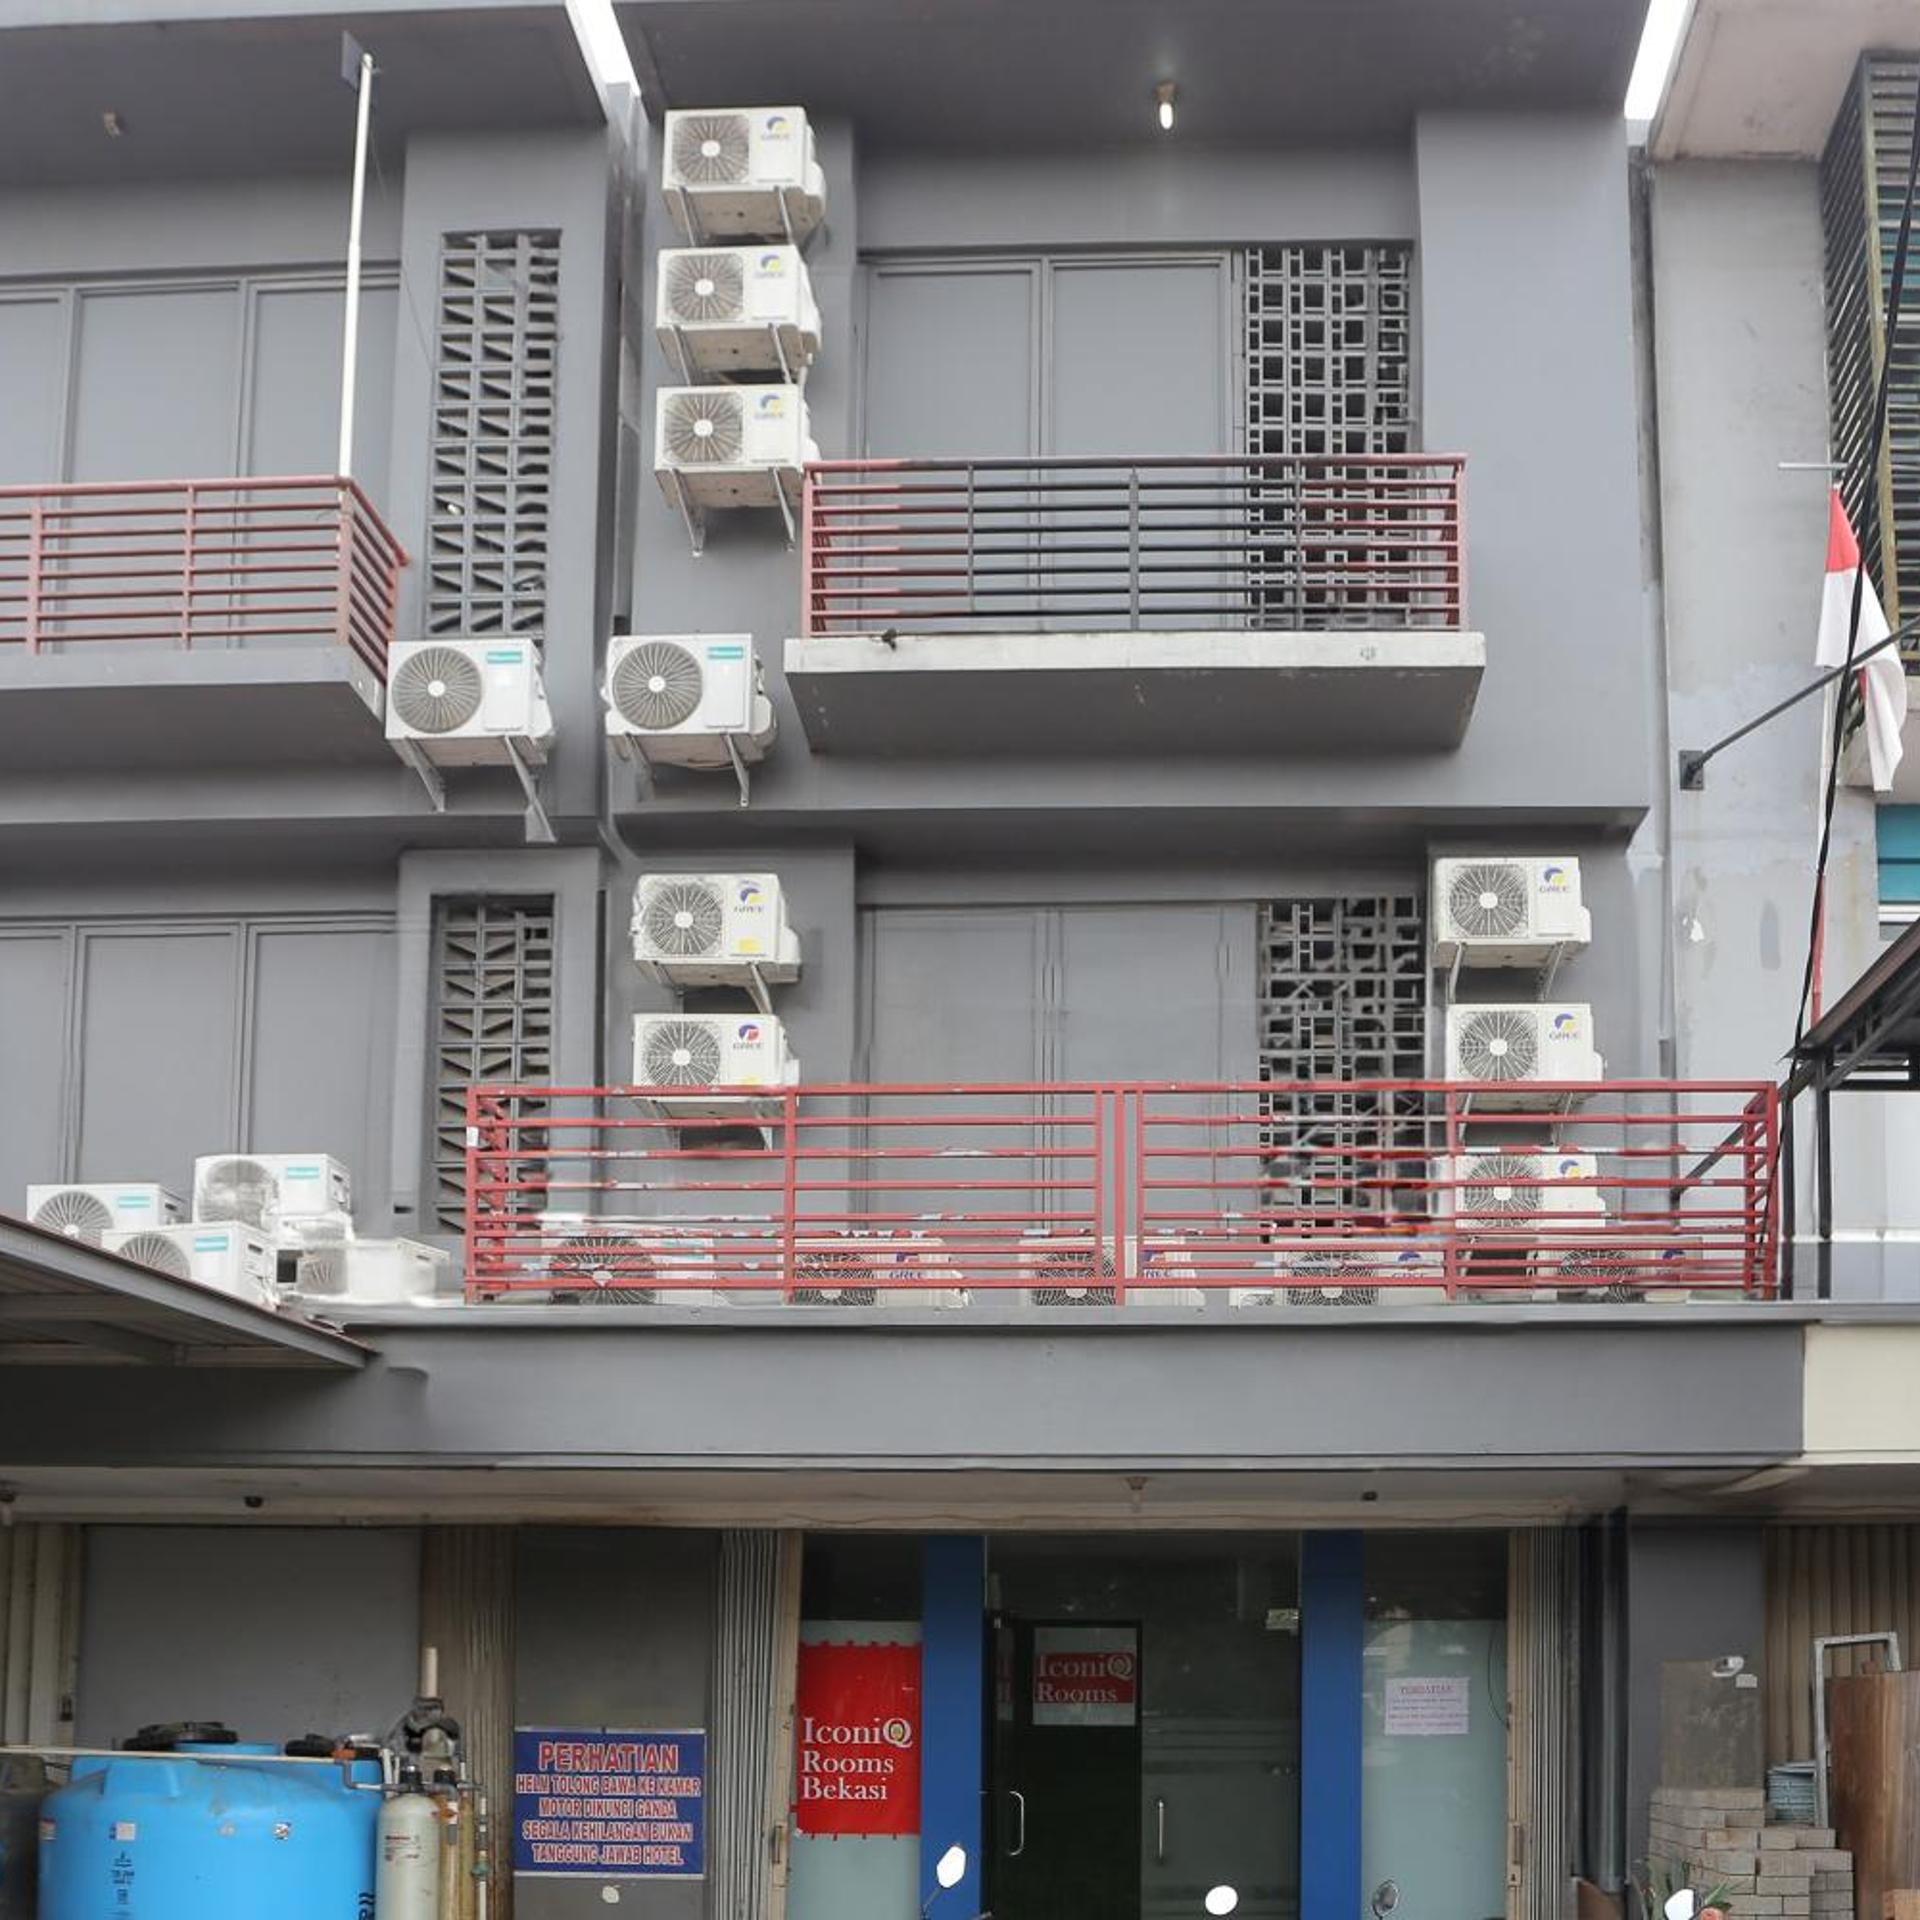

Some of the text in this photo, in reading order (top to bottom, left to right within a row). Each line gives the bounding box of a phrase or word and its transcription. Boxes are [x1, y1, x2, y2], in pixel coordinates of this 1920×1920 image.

[1037, 1681, 1118, 1703] Rooms
[803, 1717, 913, 1748] IconiQ
[538, 1741, 679, 1773] PERHATIAN
[802, 1750, 894, 1774] Rooms
[516, 1774, 701, 1797] HELM TOLONG BAWA KE KAMAR
[802, 1776, 888, 1800] Bekasi
[539, 1797, 582, 1817] MOTOR
[635, 1799, 678, 1819] GANDA
[522, 1820, 694, 1843] SEGALA KEHILANGAN BUKAN
[532, 1843, 684, 1865] TANGGUNG JAWAB HOTEL
